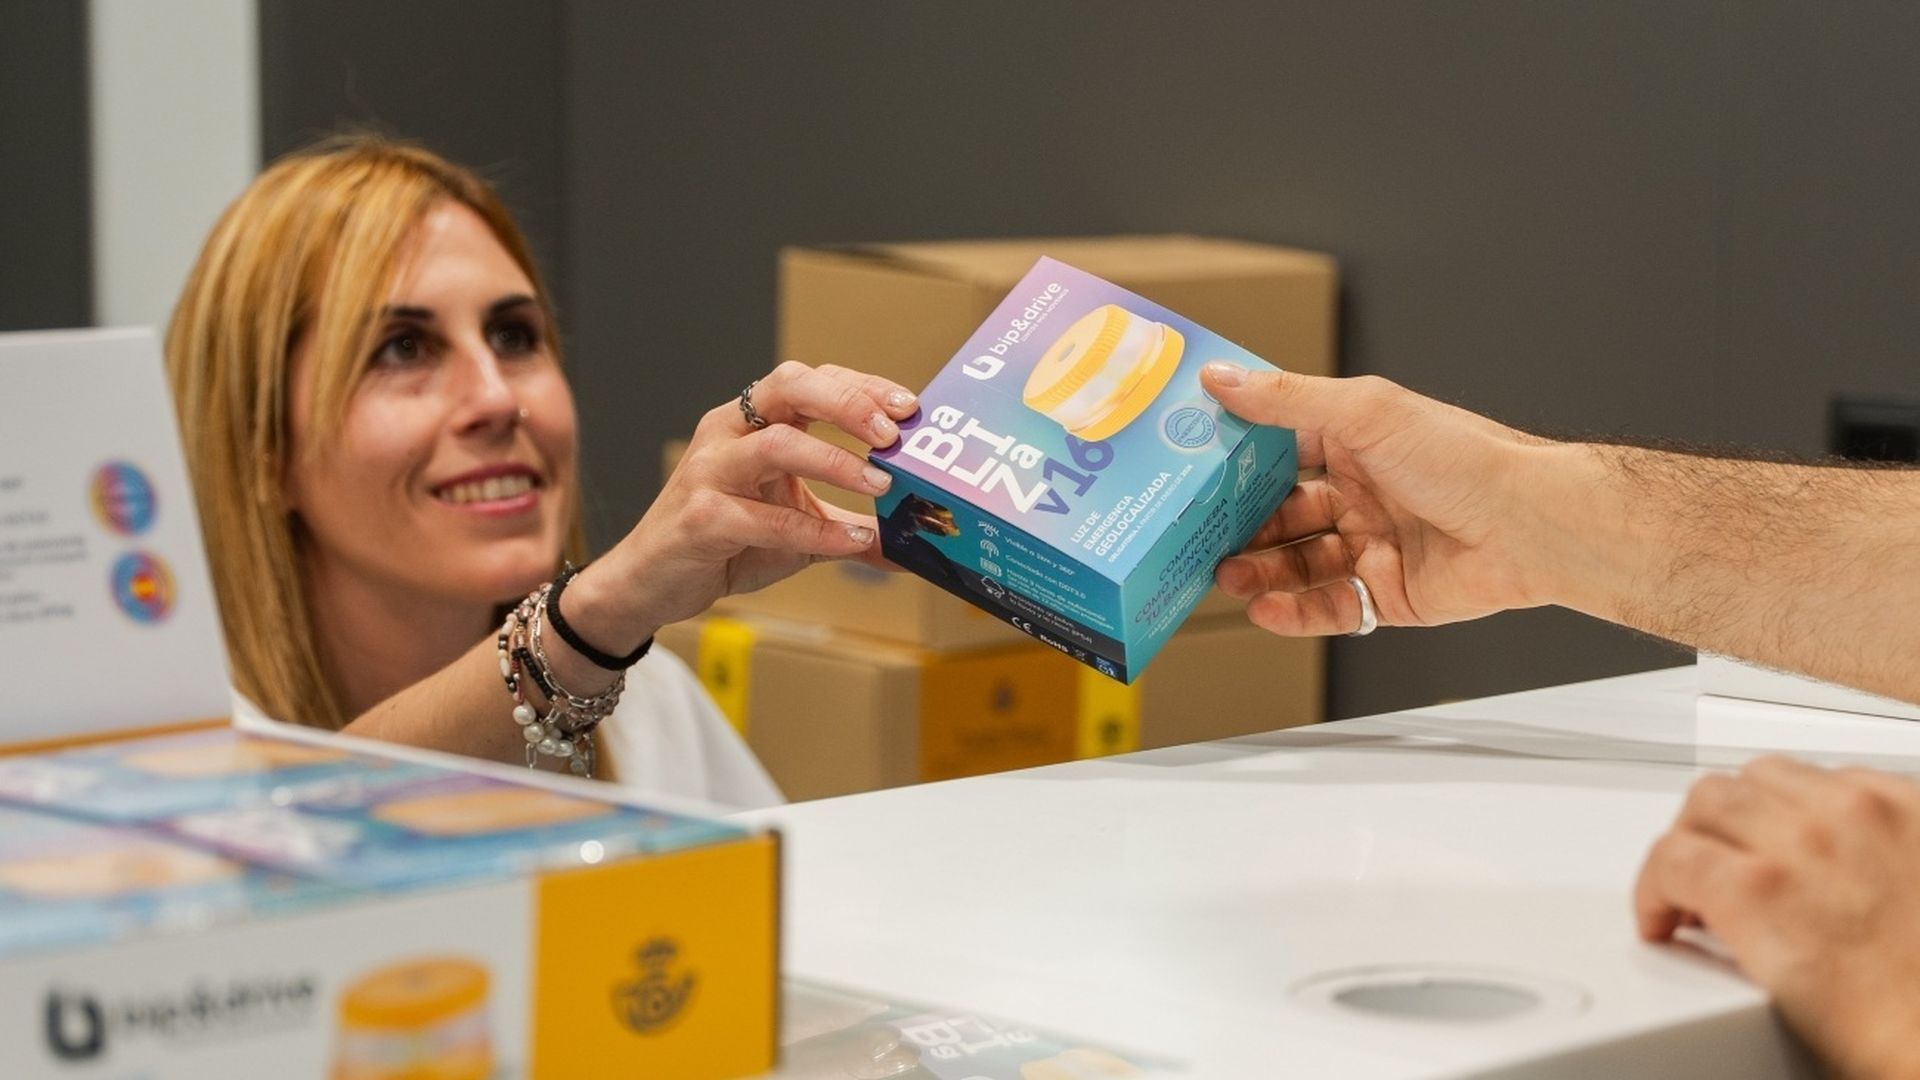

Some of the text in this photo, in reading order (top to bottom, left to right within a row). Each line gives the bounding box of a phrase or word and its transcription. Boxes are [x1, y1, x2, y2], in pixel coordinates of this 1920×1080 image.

[989, 283, 1062, 355] bip&drive
[901, 405, 965, 472] Ba
[980, 443, 1048, 514] Za
[1034, 434, 1114, 515] v16
[1070, 511, 1102, 544] LUZ DE
[1083, 495, 1134, 551] EMERGENCIA
[1095, 470, 1173, 556] GEOLOCALIZADA
[1159, 498, 1228, 581] COMPRUEBA
[1171, 512, 1229, 581] FUNCIONA
